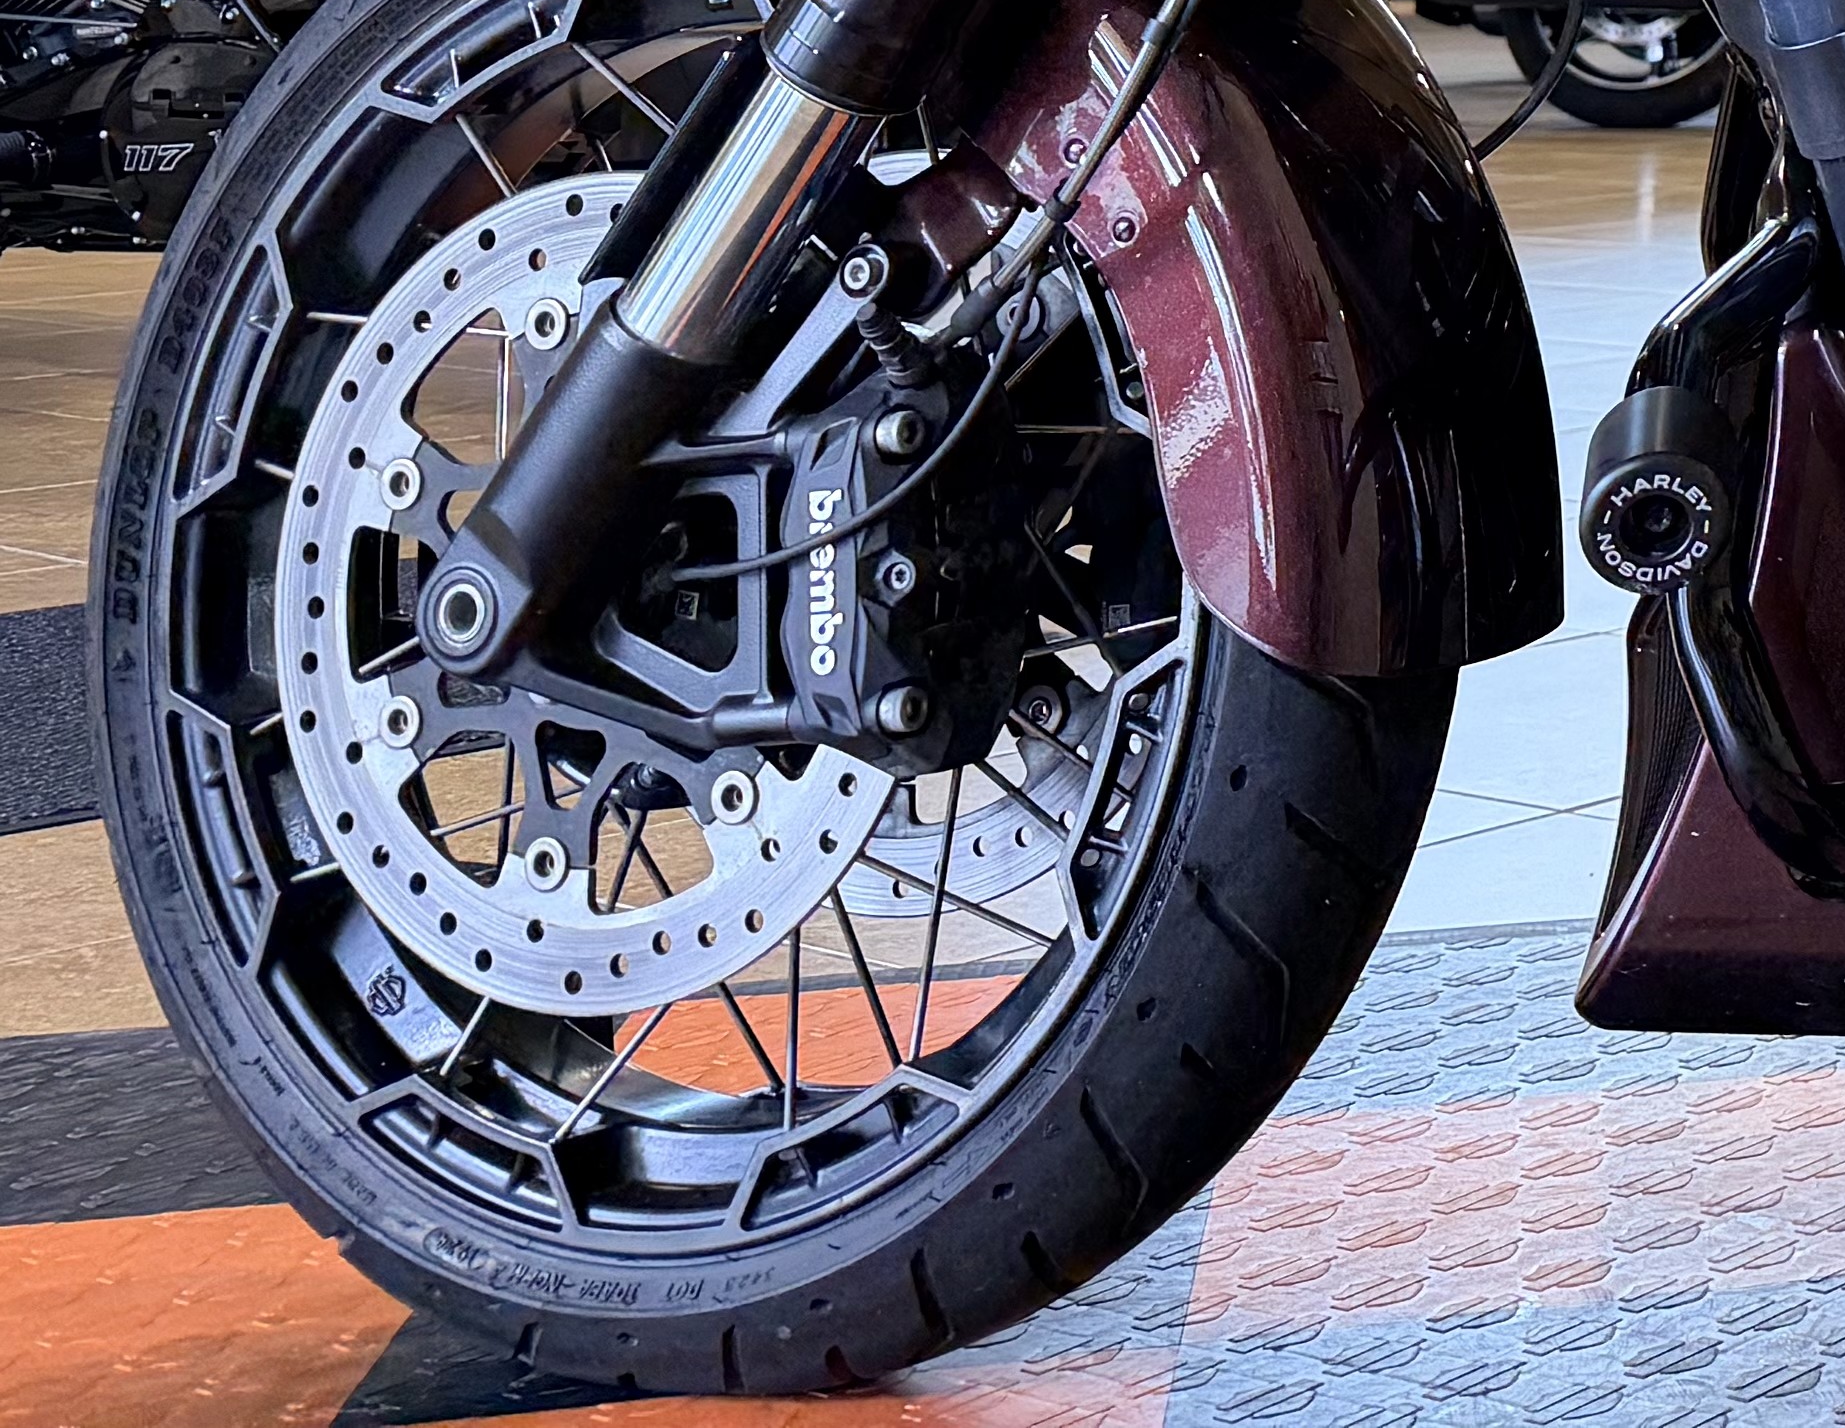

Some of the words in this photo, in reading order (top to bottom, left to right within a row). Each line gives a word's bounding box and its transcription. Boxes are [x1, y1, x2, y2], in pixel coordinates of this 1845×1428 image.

[123, 142, 195, 172] 117
[1610, 474, 1713, 511] HARLEY
[1597, 532, 1709, 582] DAVIDSON
[808, 488, 843, 676] brembo
